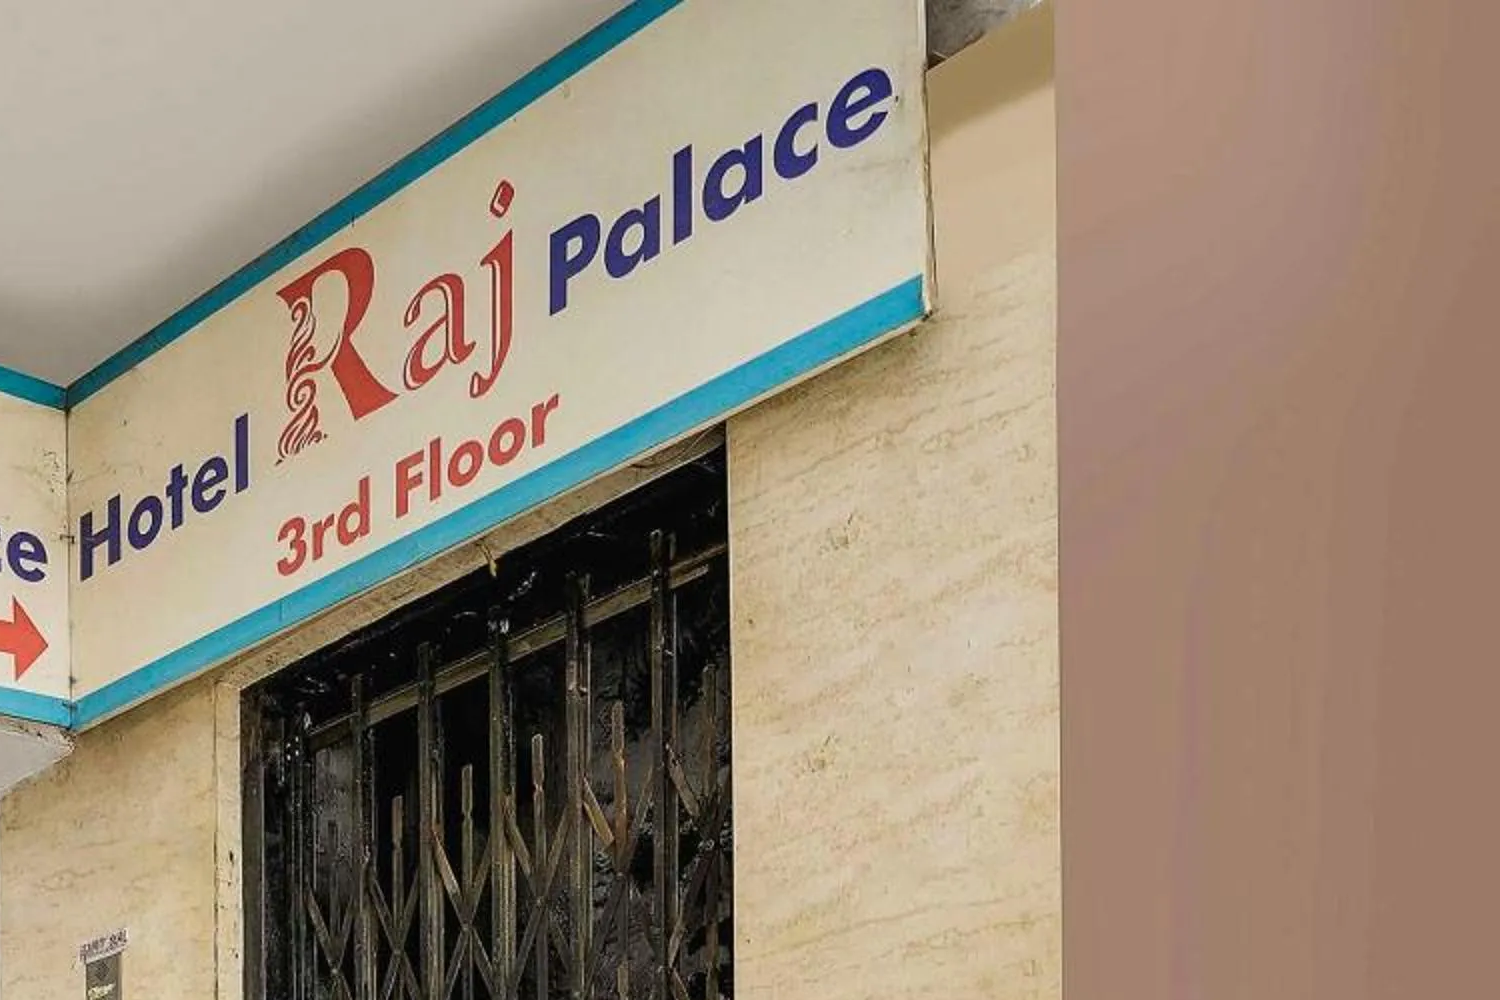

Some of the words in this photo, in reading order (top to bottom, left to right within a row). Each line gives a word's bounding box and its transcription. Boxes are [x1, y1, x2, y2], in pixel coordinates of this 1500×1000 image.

[79, 412, 249, 582] Hotel
[274, 179, 515, 466] Raj
[549, 67, 893, 317] Palace
[276, 475, 371, 578] 3rd
[395, 393, 560, 519] Floor
